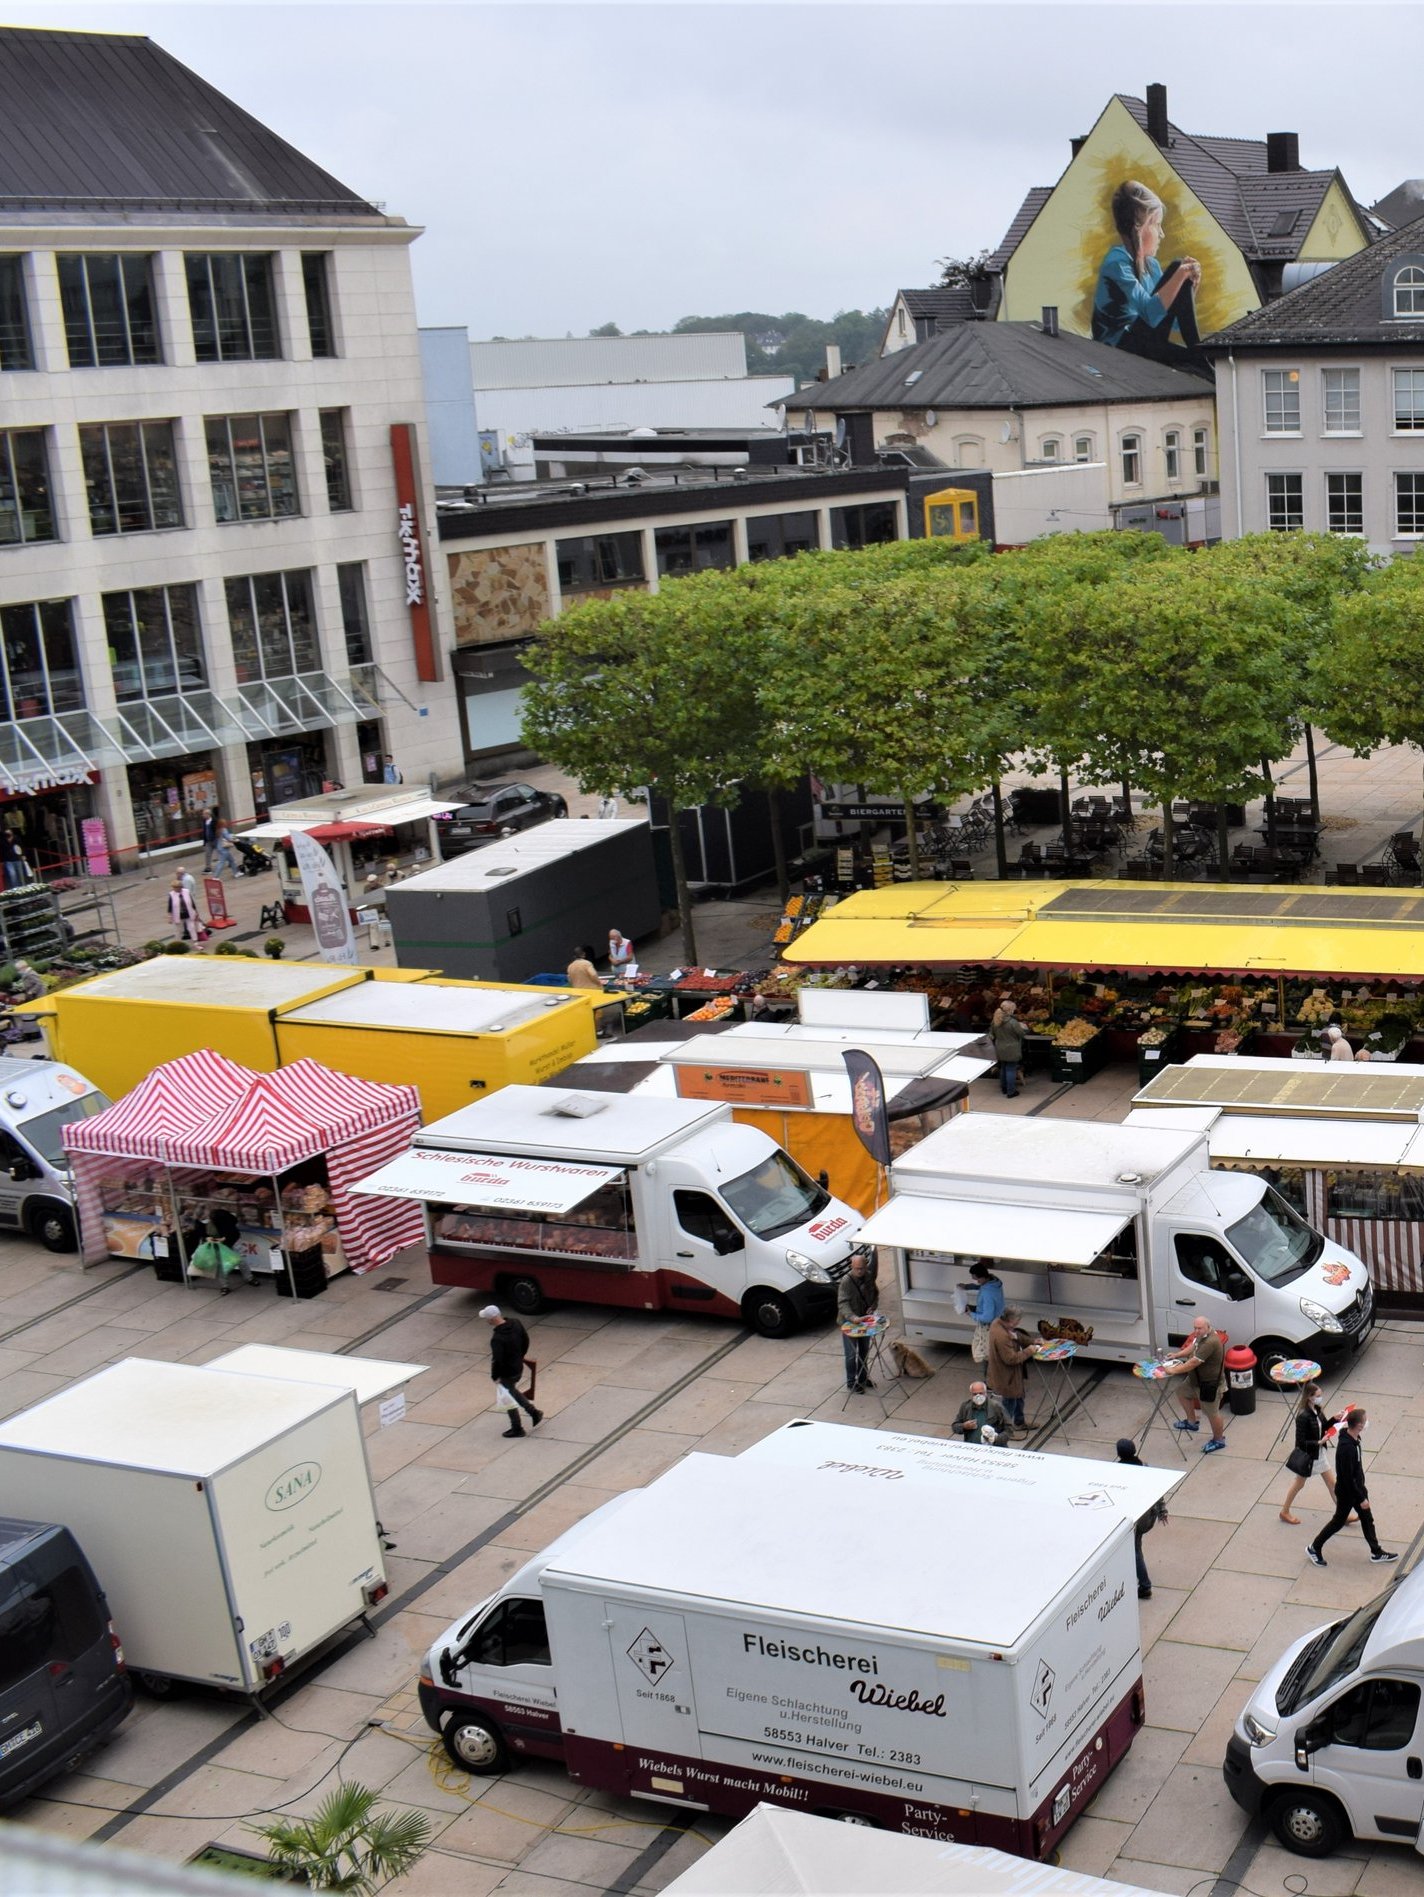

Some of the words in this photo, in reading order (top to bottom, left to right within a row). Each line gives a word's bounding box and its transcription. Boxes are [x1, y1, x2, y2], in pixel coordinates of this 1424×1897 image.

[411, 1150, 504, 1168] Schlesische
[507, 1159, 609, 1178] Wurstwaren
[459, 1174, 510, 1186] burda
[811, 1217, 848, 1241] burda
[816, 1459, 905, 1480] Wiebel
[275, 1469, 313, 1504] SANA
[1066, 1575, 1107, 1632] Fleischerei
[1098, 1581, 1125, 1622] Wiebel
[743, 1632, 878, 1675] Fleischerei
[636, 1689, 653, 1699] Seit
[655, 1692, 676, 1703] 1868
[726, 1687, 768, 1706] Eigene
[771, 1694, 849, 1720] Schlachtung
[849, 1679, 947, 1718] Wiebel
[779, 1710, 863, 1734] u.Herstellung
[764, 1726, 803, 1744] 58553
[805, 1733, 850, 1753] Halver
[857, 1743, 885, 1759] Tel.:
[889, 1749, 921, 1766] 2383
[639, 1758, 683, 1777] Wiebels
[685, 1766, 720, 1784] Wurst
[723, 1774, 760, 1792] macht
[763, 1781, 809, 1801] Mobil!!
[752, 1751, 924, 1793] www.fleischerei-wiebel.eu
[1072, 1750, 1093, 1781] Party-
[1071, 1763, 1097, 1802] Service
[904, 1804, 948, 1824] Party-
[901, 1821, 955, 1843] Service
